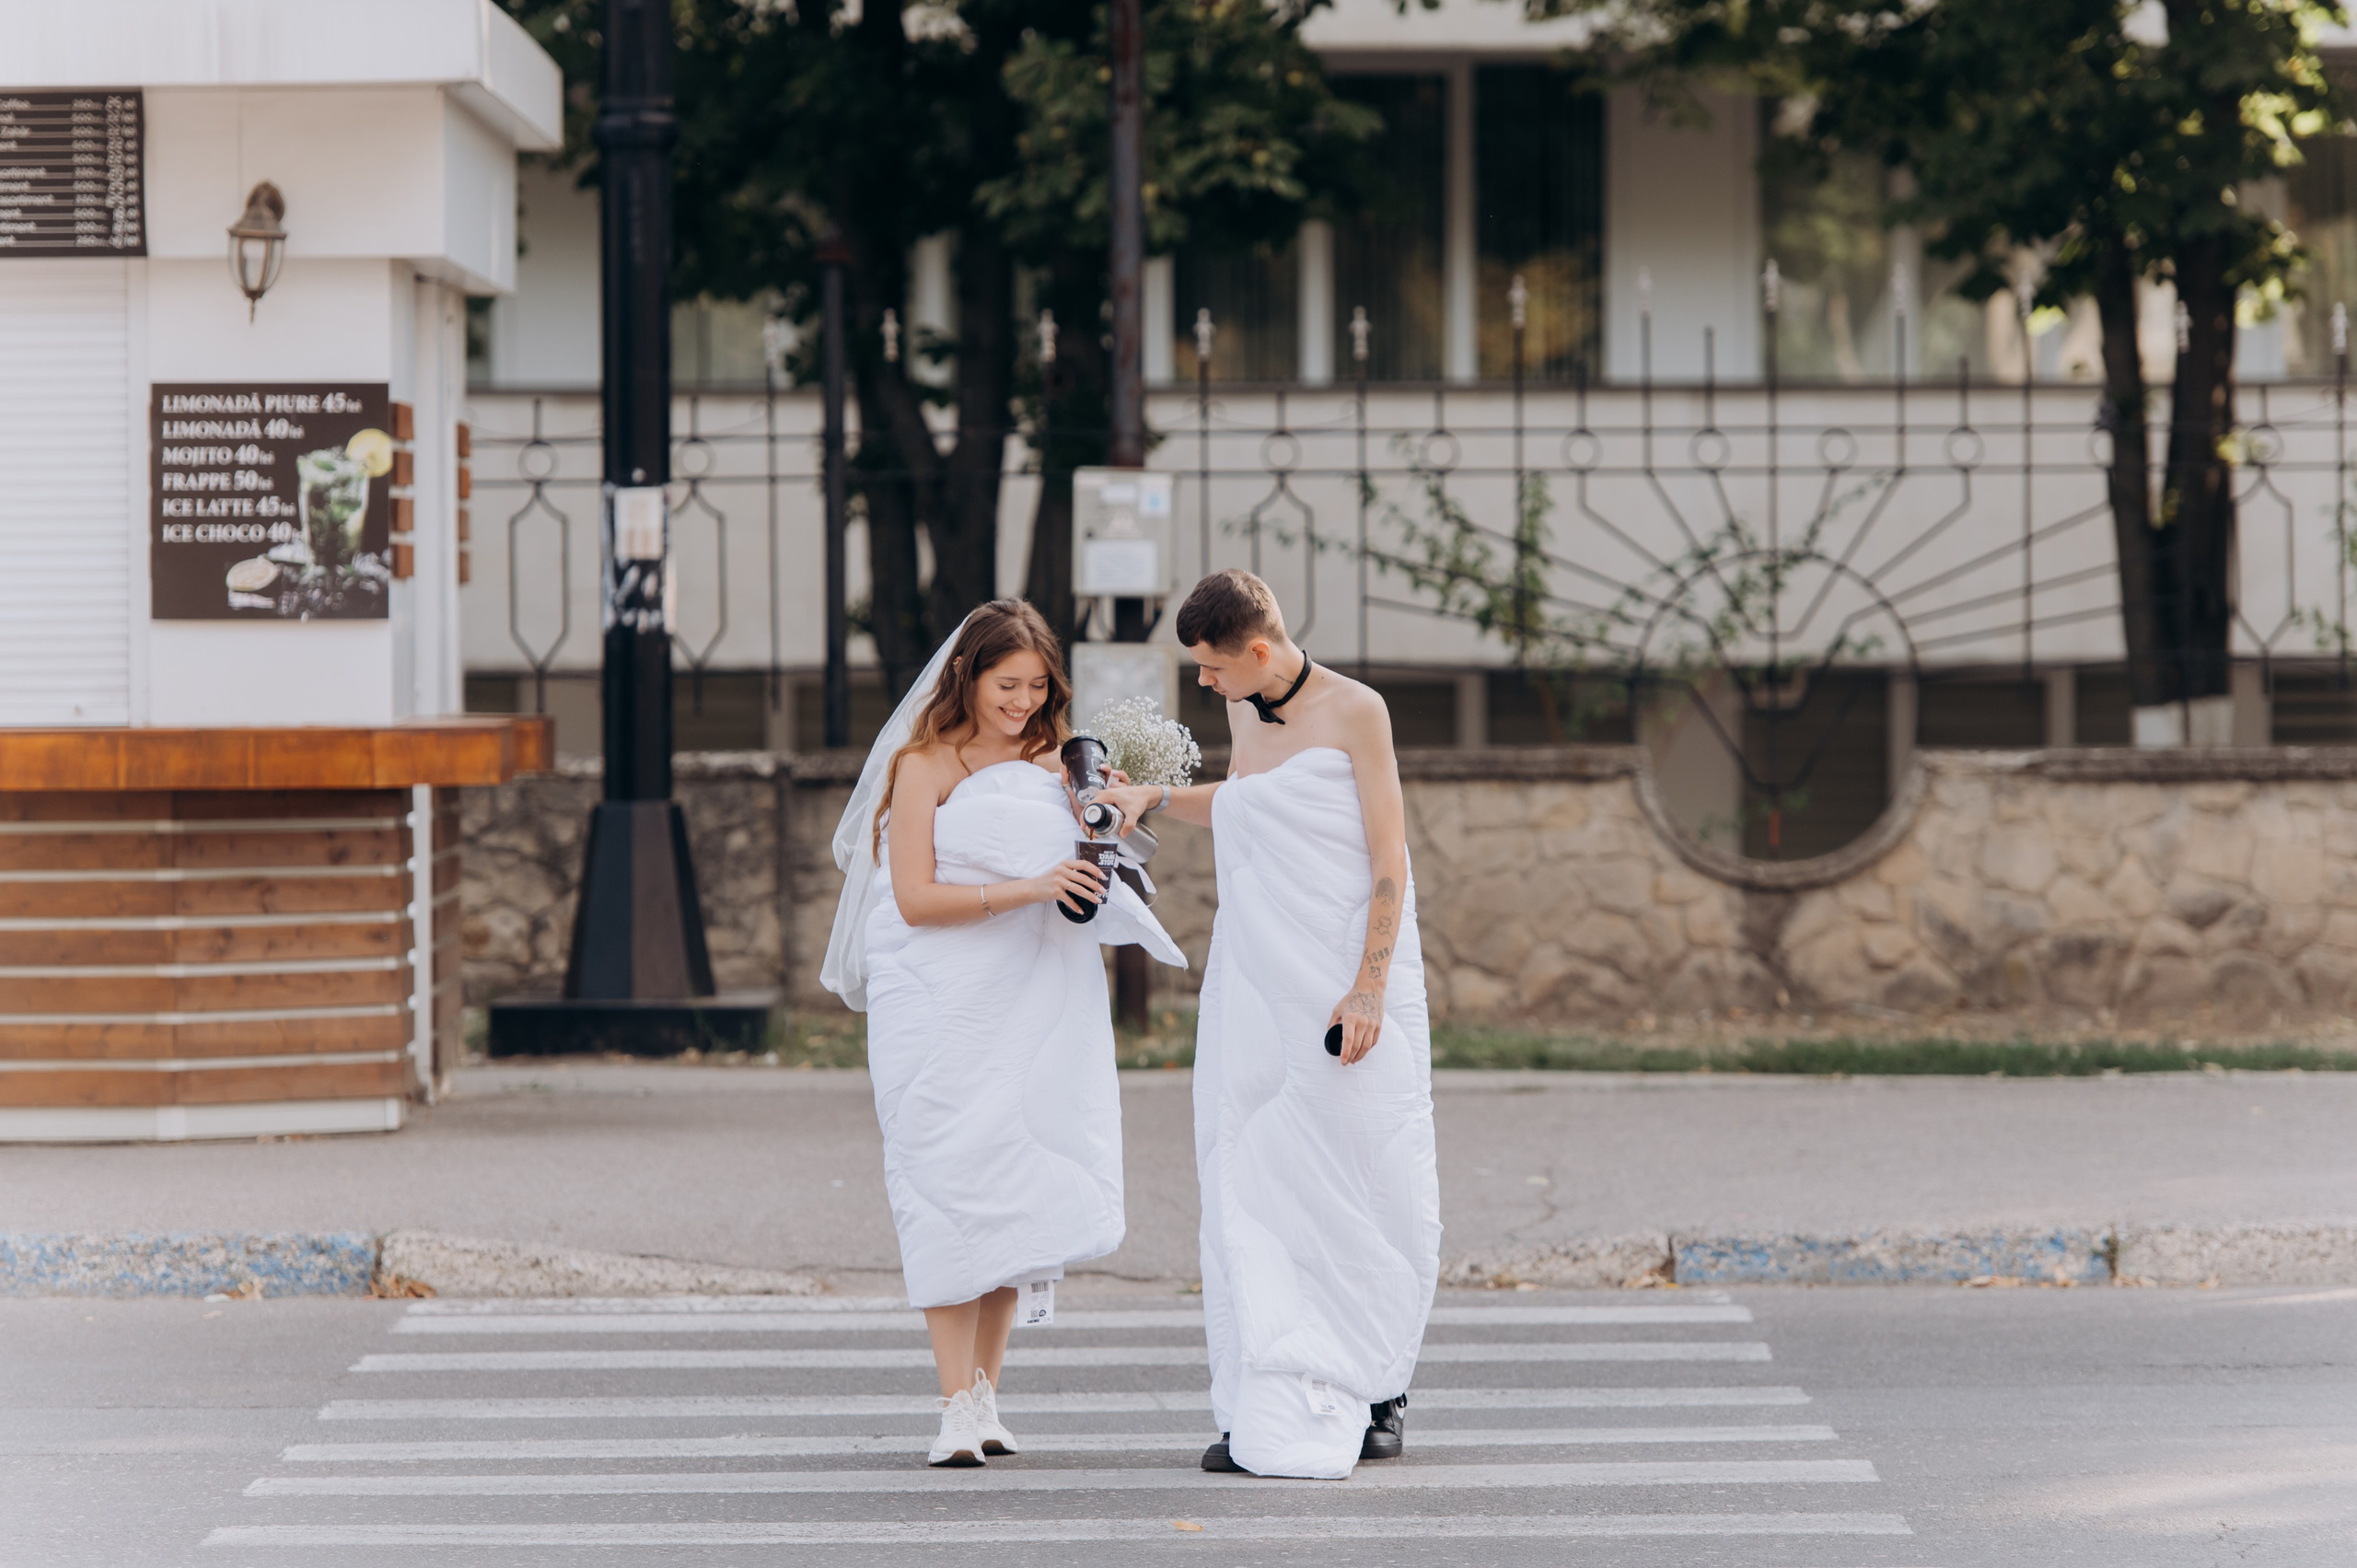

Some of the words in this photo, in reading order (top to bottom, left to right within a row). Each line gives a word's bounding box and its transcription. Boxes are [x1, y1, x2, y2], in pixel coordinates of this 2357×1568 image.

[162, 391, 263, 413] LIMONADĂ
[264, 394, 323, 413] PIURE
[162, 417, 263, 439] LIMONADĂ
[162, 446, 234, 468] MOJITO
[162, 472, 233, 491] FRAPPE
[162, 498, 195, 517] ICE
[196, 498, 256, 517] LATTE
[162, 524, 195, 543] ICE
[195, 524, 266, 543] CHOCO
